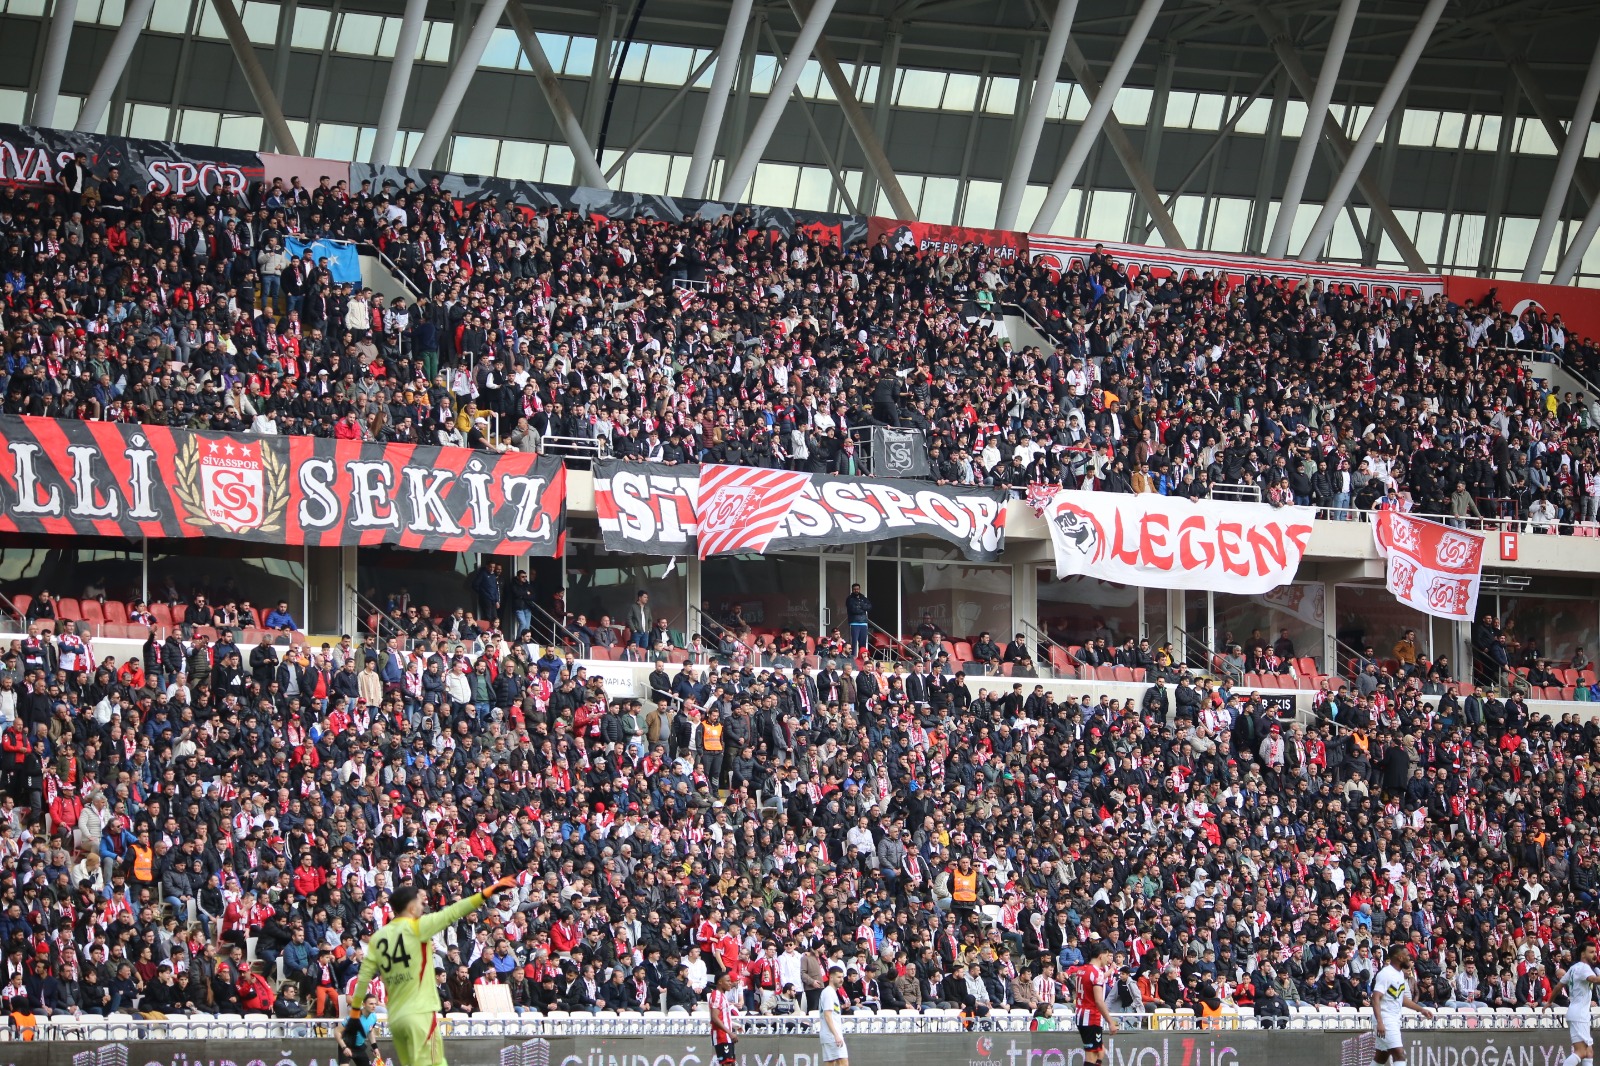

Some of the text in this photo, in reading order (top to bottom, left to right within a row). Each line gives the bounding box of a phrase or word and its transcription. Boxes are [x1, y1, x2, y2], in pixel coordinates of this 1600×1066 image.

[147, 161, 250, 208] SPOR
[203, 454, 259, 470] SİVASSPOR
[0, 434, 551, 541] LLİ SEKİZ
[209, 508, 224, 518] 1967
[1504, 536, 1515, 556] F
[376, 933, 411, 973] 34
[1392, 1038, 1576, 1066] ÜNDOĞAN YA
